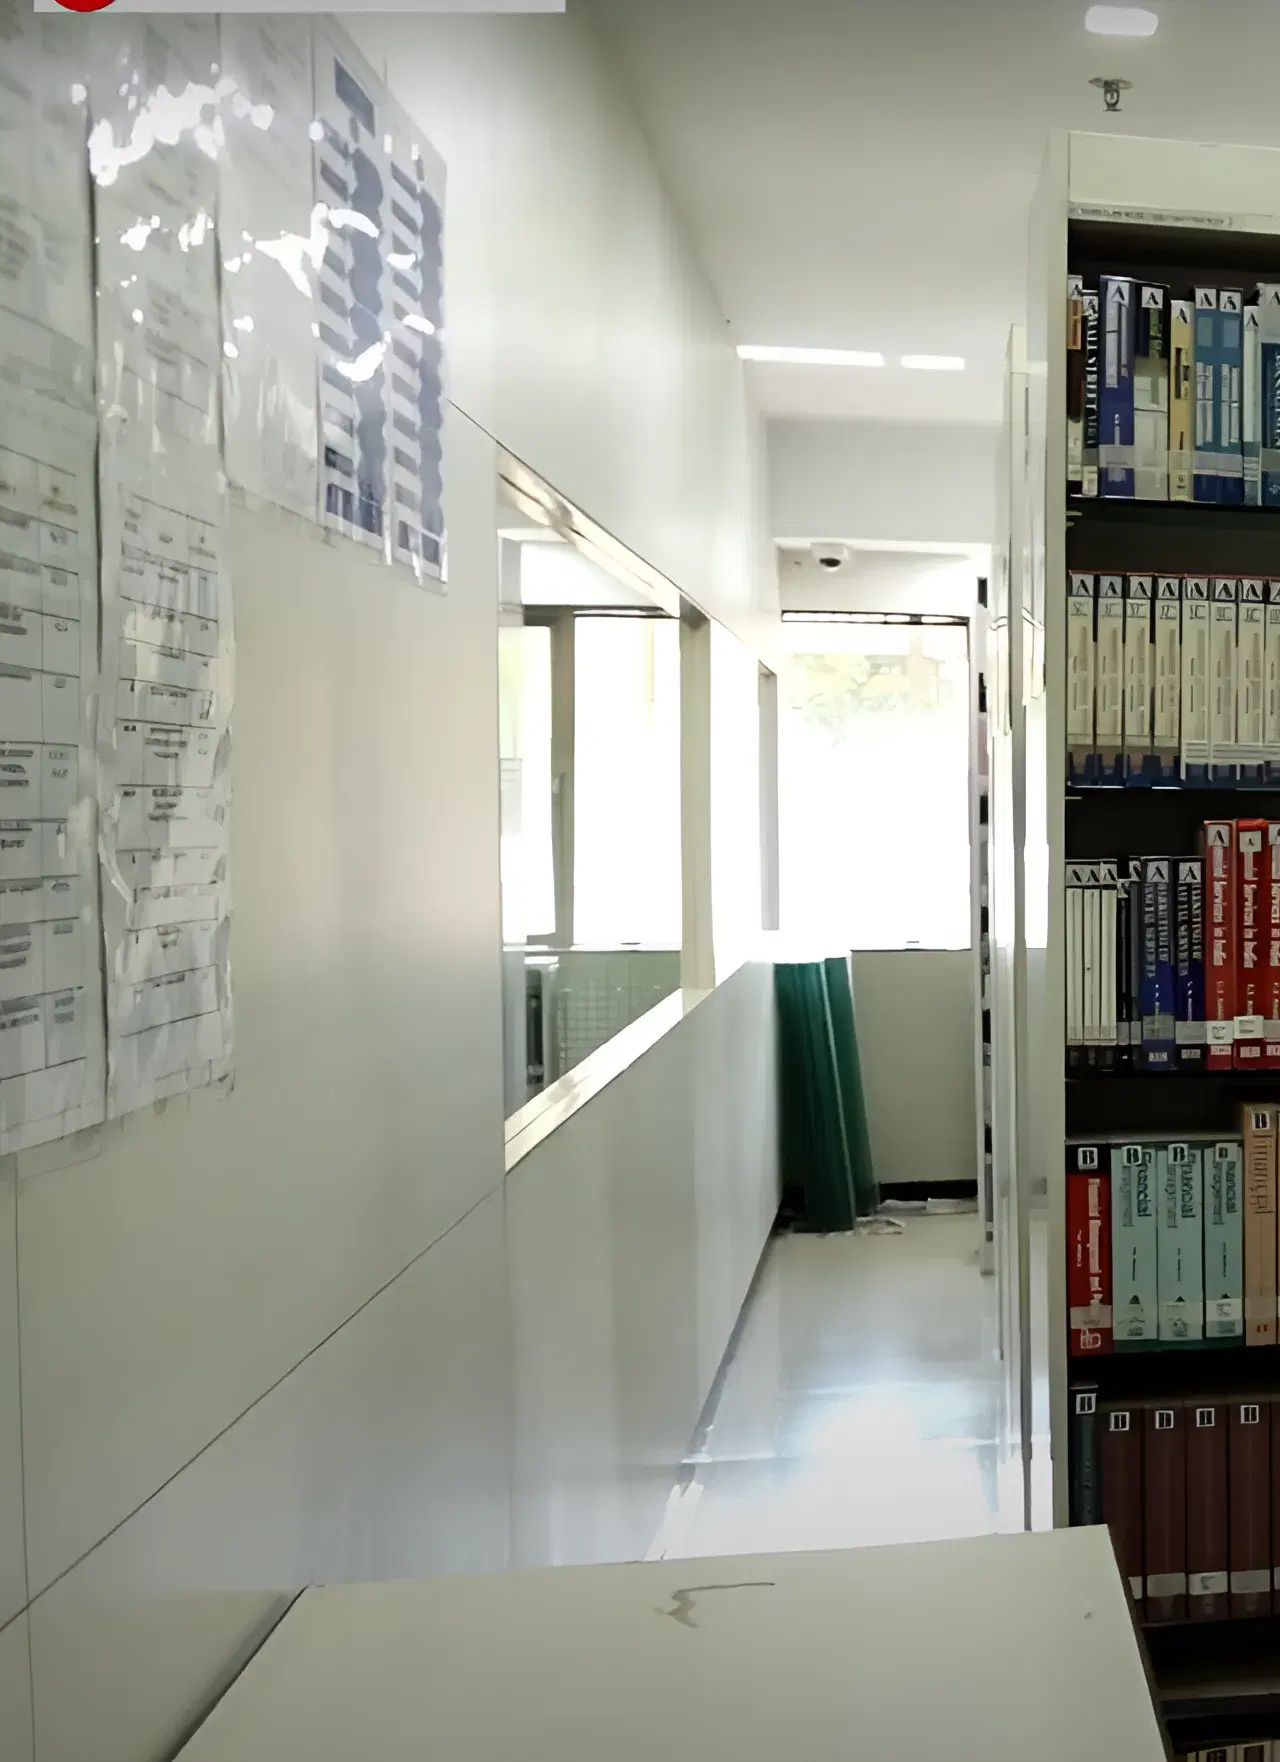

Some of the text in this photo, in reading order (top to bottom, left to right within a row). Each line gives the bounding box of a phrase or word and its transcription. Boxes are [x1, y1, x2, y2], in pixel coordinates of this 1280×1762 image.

[1111, 285, 1126, 300] A
[1146, 291, 1159, 305] A
[1223, 296, 1237, 310] A
[1176, 309, 1188, 324] A
[1107, 581, 1118, 595] A
[1137, 581, 1149, 596] A
[1161, 581, 1176, 595] A
[1218, 582, 1233, 597] A
[1246, 582, 1260, 597] A
[1213, 829, 1226, 846] A
[1072, 869, 1083, 882] A
[1087, 869, 1100, 882] A
[1103, 868, 1116, 881] A
[1151, 865, 1166, 881] A
[1182, 866, 1198, 881] A
